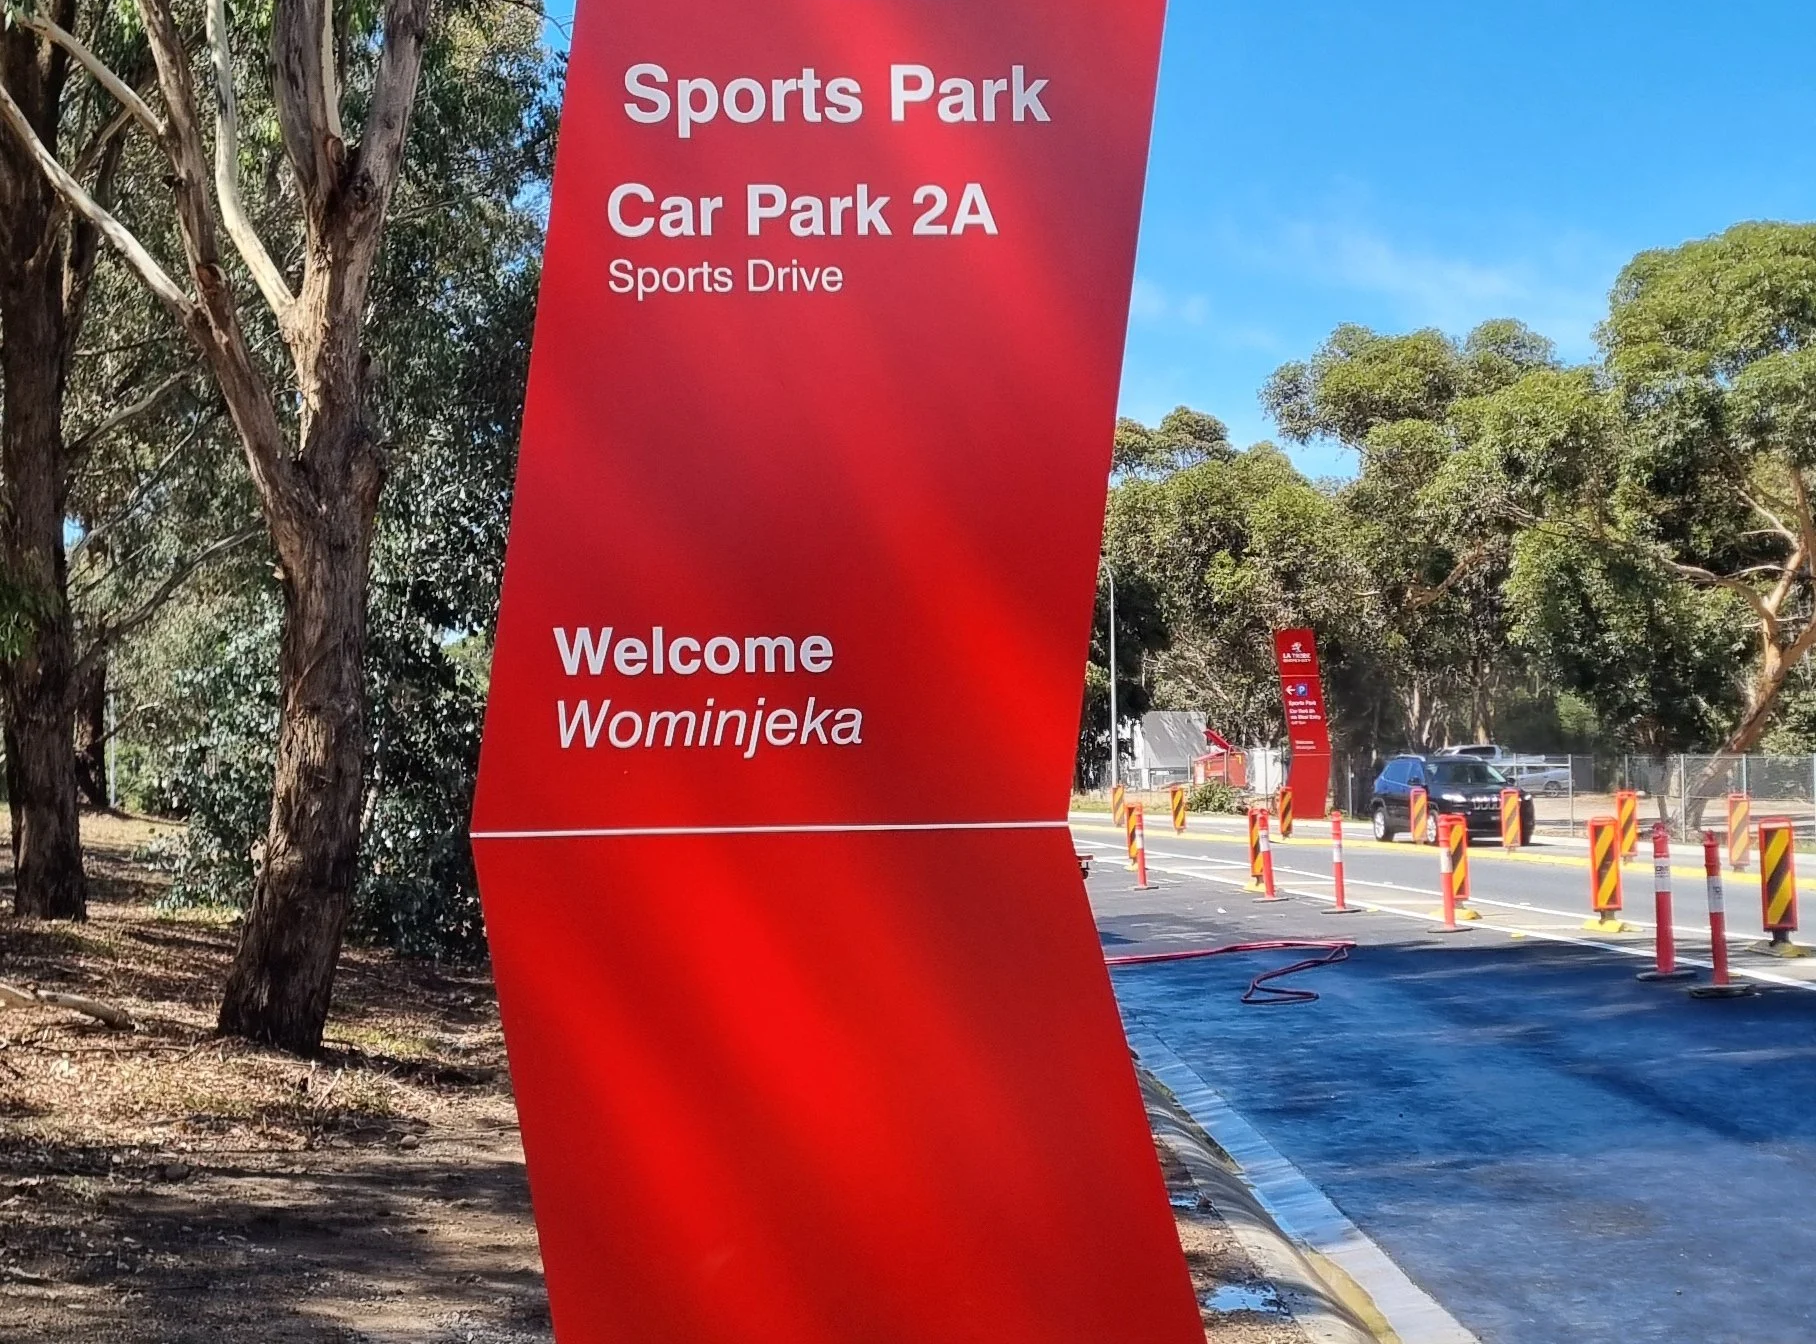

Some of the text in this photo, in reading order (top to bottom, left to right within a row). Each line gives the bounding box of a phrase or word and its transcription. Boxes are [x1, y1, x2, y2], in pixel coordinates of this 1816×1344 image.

[623, 63, 1052, 139] Sports Park
[607, 182, 1000, 238] Car Park 2A
[608, 258, 844, 302] Sports Drive
[552, 626, 834, 676] Welcome
[557, 696, 864, 759] Wominjeka
